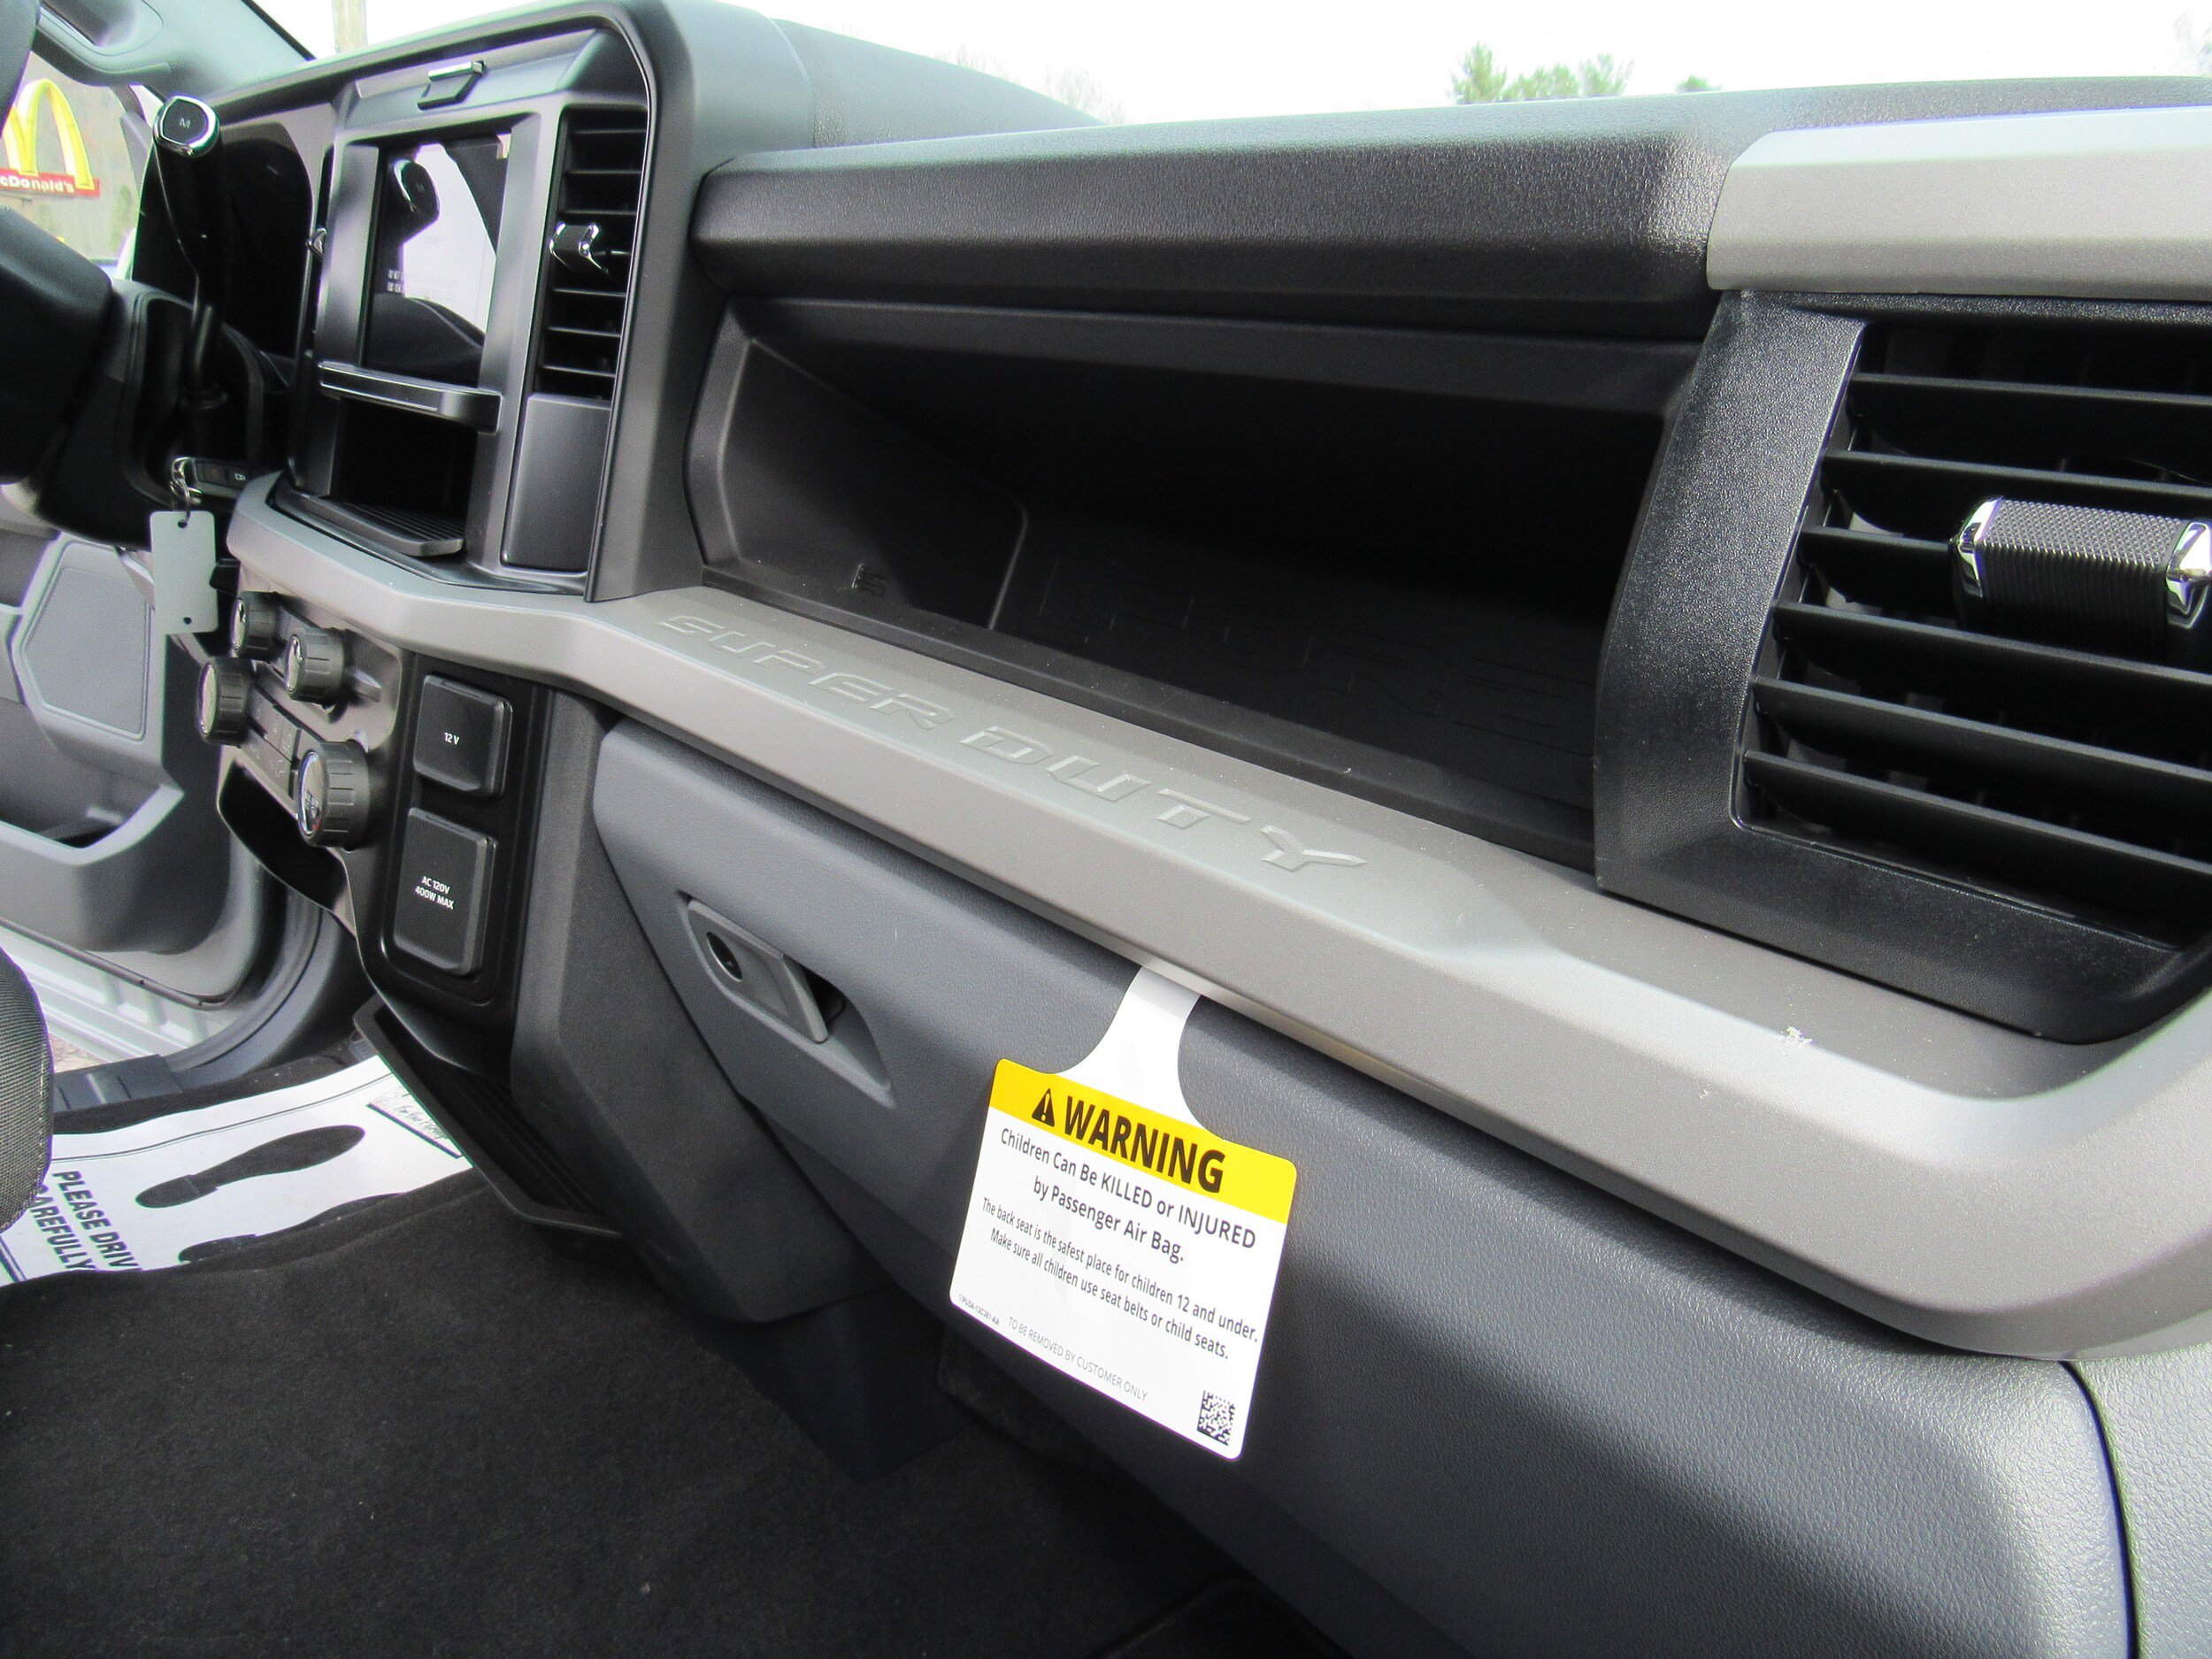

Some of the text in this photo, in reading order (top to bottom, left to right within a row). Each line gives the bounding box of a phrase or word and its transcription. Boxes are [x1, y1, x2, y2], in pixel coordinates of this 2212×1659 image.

[0, 175, 74, 192] cDonald's
[444, 732, 453, 743] 12
[657, 615, 956, 730] SUPER
[959, 725, 1367, 872] DUTY
[415, 886, 454, 910] 400W MAX
[421, 876, 450, 895] AC 120V
[1001, 1128, 1256, 1248] Children Can Be KILLED or INJURED
[1064, 1095, 1226, 1194] WARNING
[51, 1171, 112, 1231] PLEASE
[1033, 1175, 1184, 1264] by Passenger Air Bag.
[982, 1197, 1258, 1342] The back seat is the safest place for children 12 and under.
[990, 1227, 1229, 1360] Make sure all children use seat belts or child seats.
[1009, 1316, 1148, 1402] TO BE REMOVED BY CUSTOMER ONLY
